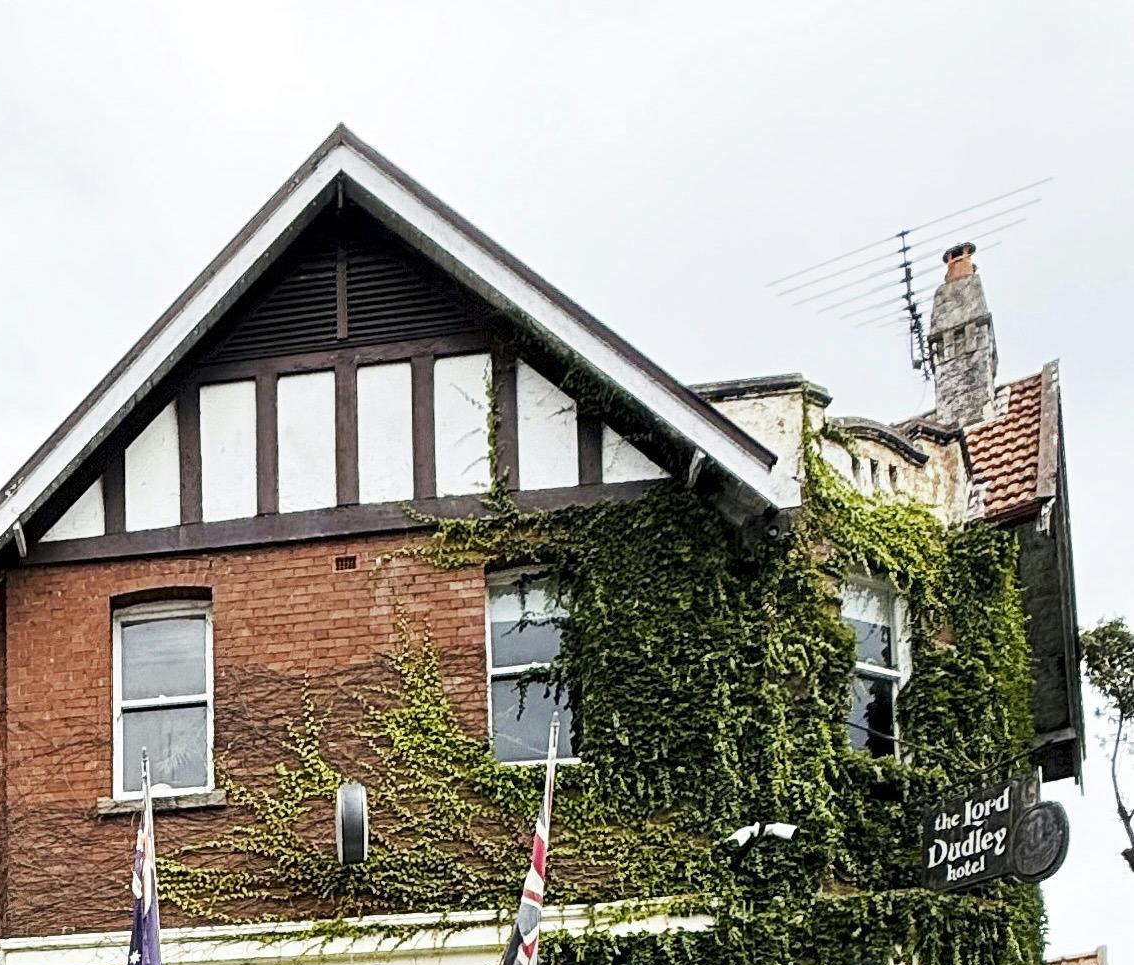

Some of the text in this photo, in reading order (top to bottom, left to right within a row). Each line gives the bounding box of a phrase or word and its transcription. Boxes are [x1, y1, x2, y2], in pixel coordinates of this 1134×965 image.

[934, 786, 1011, 832] the Lord
[927, 827, 1007, 869] Dudley
[946, 855, 985, 881] hotel
